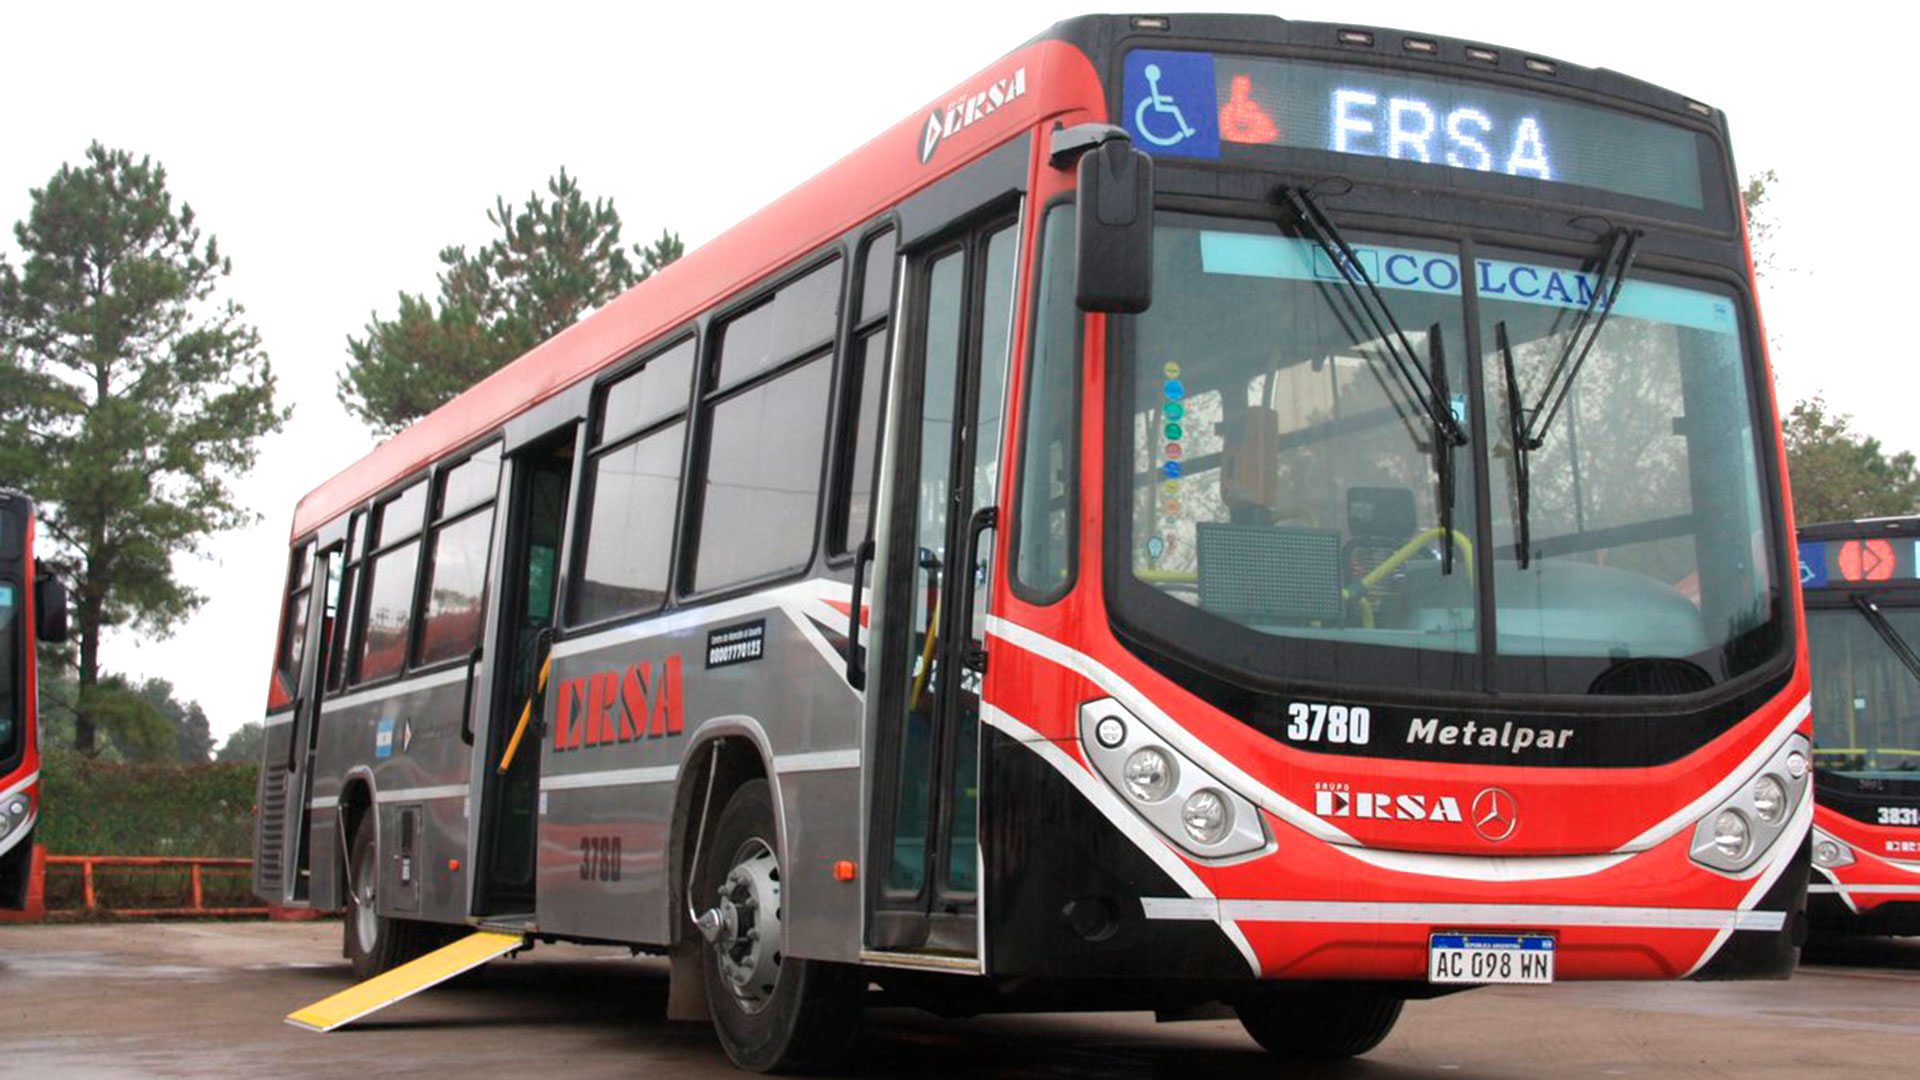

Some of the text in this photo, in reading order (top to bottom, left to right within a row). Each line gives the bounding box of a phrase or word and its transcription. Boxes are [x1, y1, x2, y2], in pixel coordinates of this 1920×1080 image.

[1331, 88, 1552, 180] ERSA
[553, 651, 684, 752] ERSA
[1287, 702, 1574, 753] 3780 Metalpar
[1314, 781, 1350, 791] GRUPO
[1315, 791, 1463, 822] ERSA
[1877, 807, 1918, 825] 3831
[579, 838, 622, 882] 3780
[1437, 952, 1547, 979] AC 098 WN
